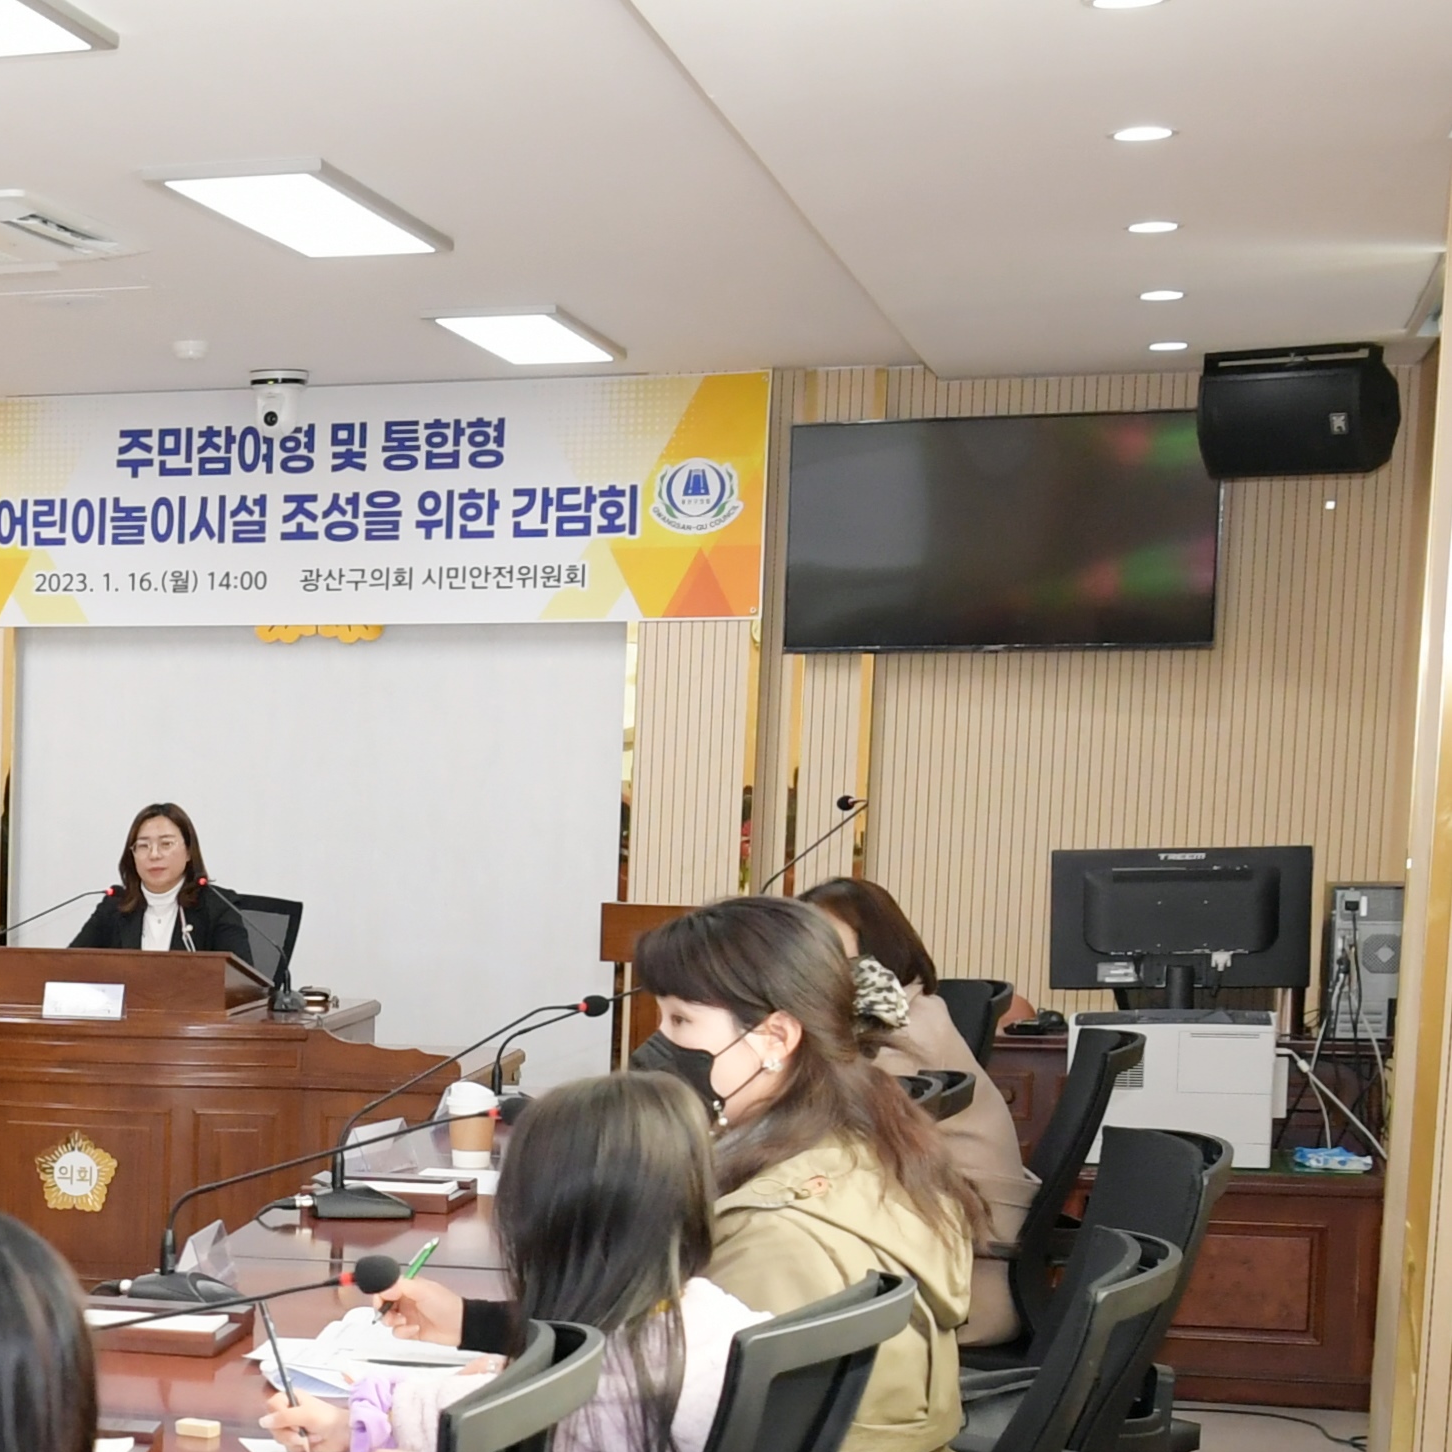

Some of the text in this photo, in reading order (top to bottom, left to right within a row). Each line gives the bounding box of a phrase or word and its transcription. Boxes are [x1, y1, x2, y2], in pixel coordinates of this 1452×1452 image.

[115, 417, 506, 479] 주민참여형 및 통합형
[279, 489, 403, 542] 조성을
[415, 487, 501, 540] 위한
[511, 483, 639, 538] 간담회
[34, 563, 587, 594] 2023. 1. 16.(월) 14:00 광산구의회 시민안전위원회
[57, 1164, 93, 1187] 의회
